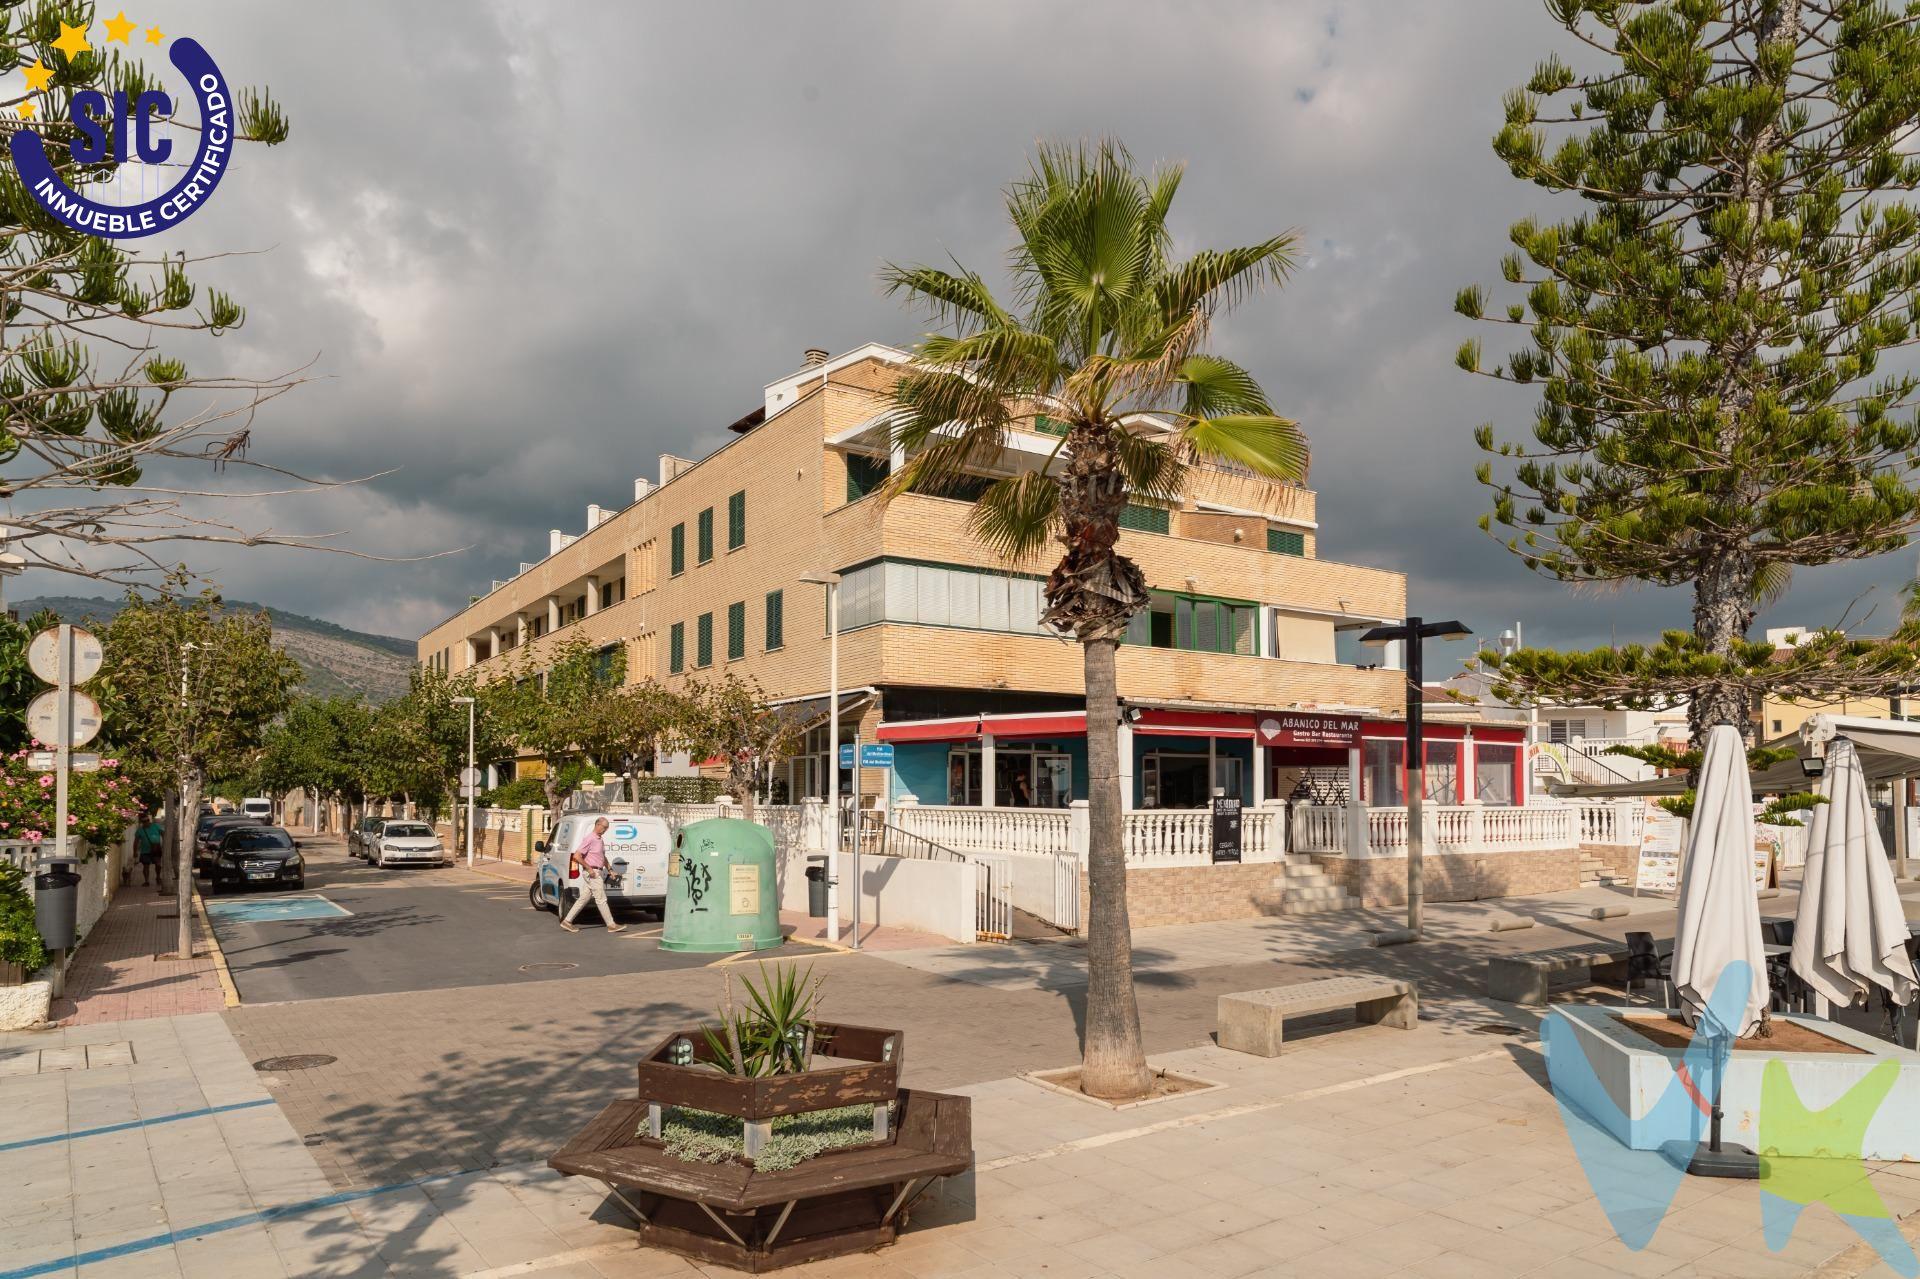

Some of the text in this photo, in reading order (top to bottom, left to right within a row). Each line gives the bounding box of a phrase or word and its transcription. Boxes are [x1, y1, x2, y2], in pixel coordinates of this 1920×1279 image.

[1282, 718, 1359, 731] ABANICO DEL MAR
[1322, 731, 1353, 739] Restaurante
